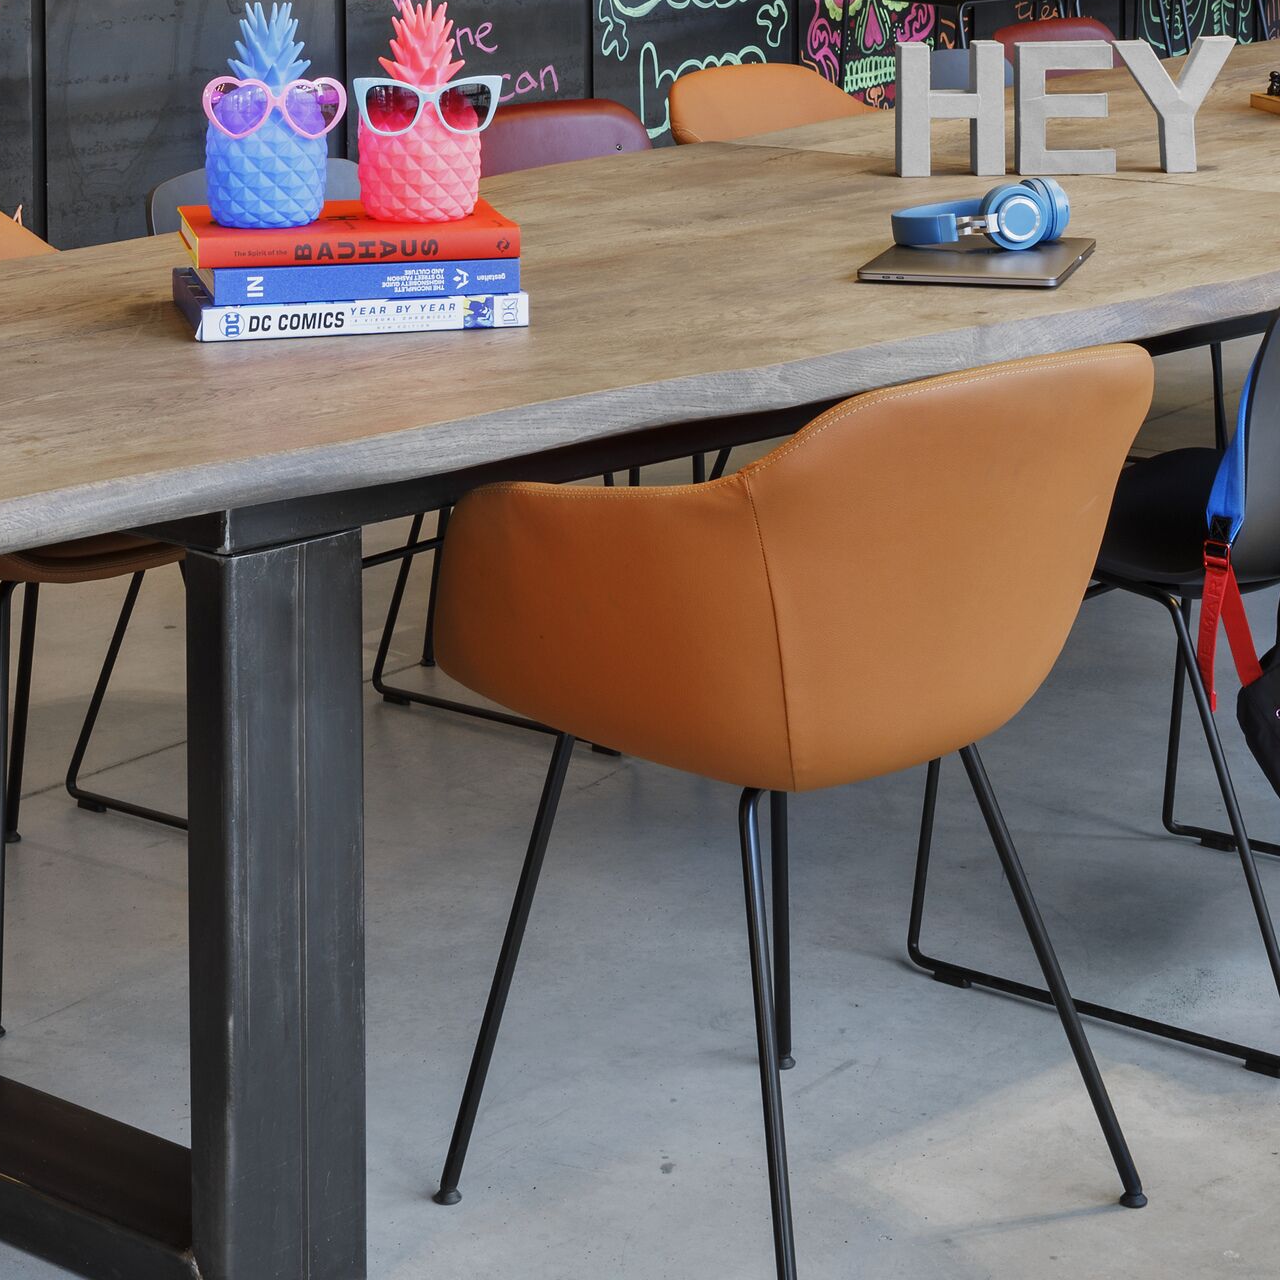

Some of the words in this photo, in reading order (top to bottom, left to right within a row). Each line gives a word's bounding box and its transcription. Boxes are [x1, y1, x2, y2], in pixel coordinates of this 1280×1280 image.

[895, 36, 1236, 178] HEY
[247, 250, 267, 258] Spirit
[294, 239, 438, 261] BAUHAUS
[404, 268, 431, 276] CULTURE
[248, 315, 272, 333] DC
[278, 311, 345, 331] COMICS
[350, 306, 387, 316] YEAR
[395, 305, 412, 314] BY
[419, 303, 456, 312] YEAR
[502, 298, 519, 325] DK
